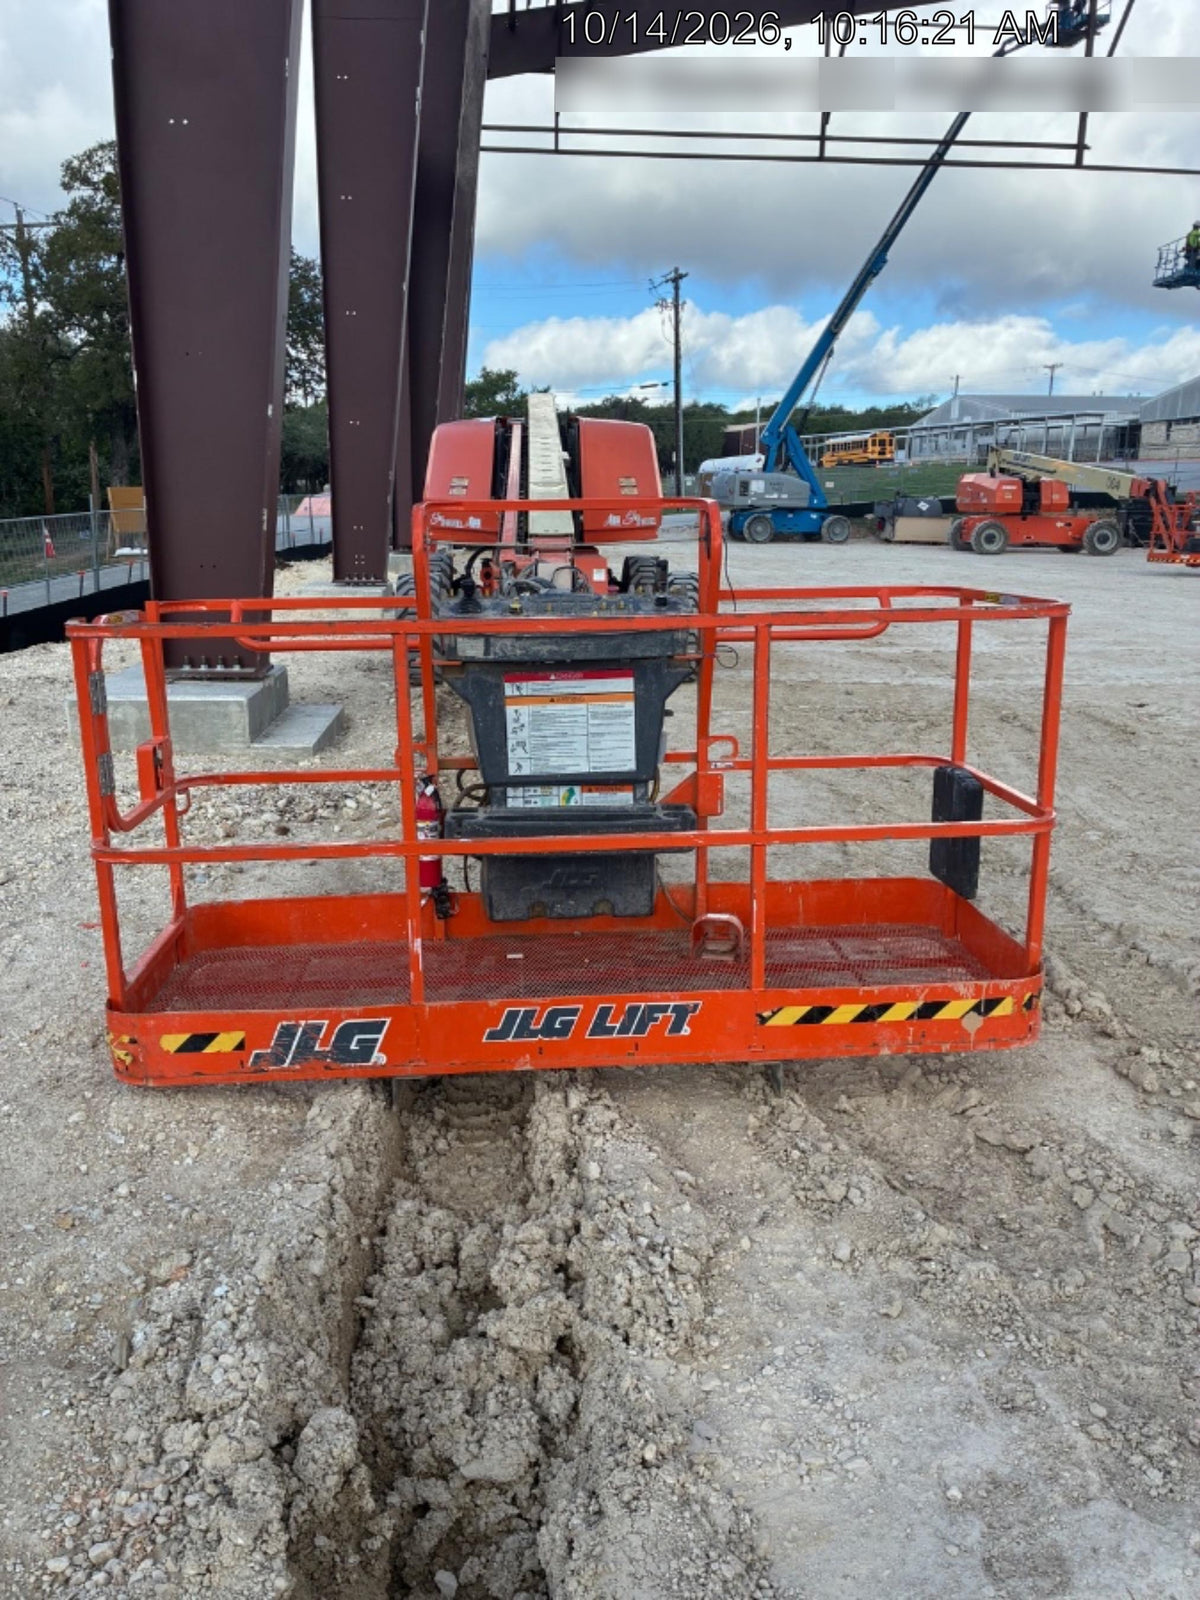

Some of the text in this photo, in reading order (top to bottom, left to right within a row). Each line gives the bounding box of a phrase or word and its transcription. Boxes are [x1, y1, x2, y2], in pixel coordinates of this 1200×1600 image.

[249, 1018, 391, 1070] JLG
[482, 1001, 702, 1042] JLG LIFT
